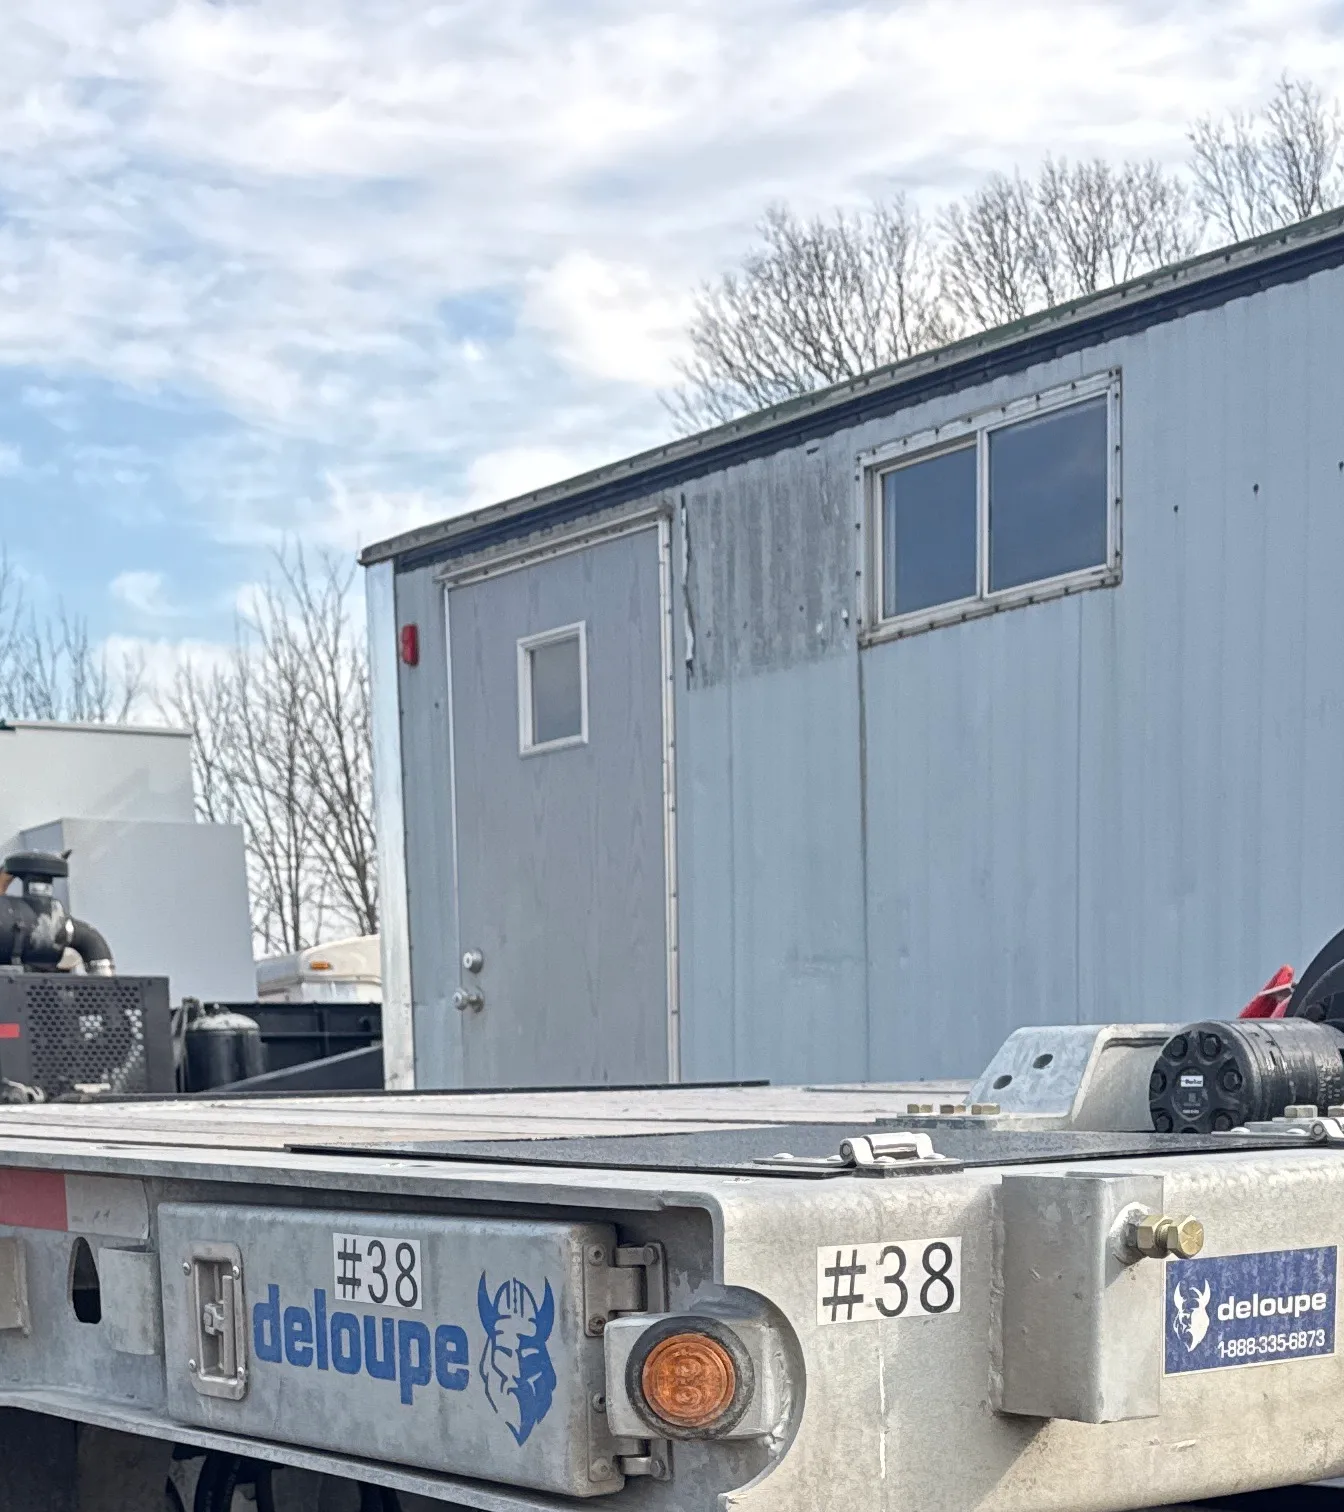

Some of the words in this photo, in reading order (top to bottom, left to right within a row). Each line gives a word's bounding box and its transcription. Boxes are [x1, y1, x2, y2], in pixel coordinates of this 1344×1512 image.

[337, 1237, 418, 1308] #38
[822, 1241, 955, 1322] #38
[1217, 1292, 1327, 1321] deloupe
[252, 1283, 470, 1406] deloupe
[1218, 1329, 1326, 1358] 1-888-335-6873
